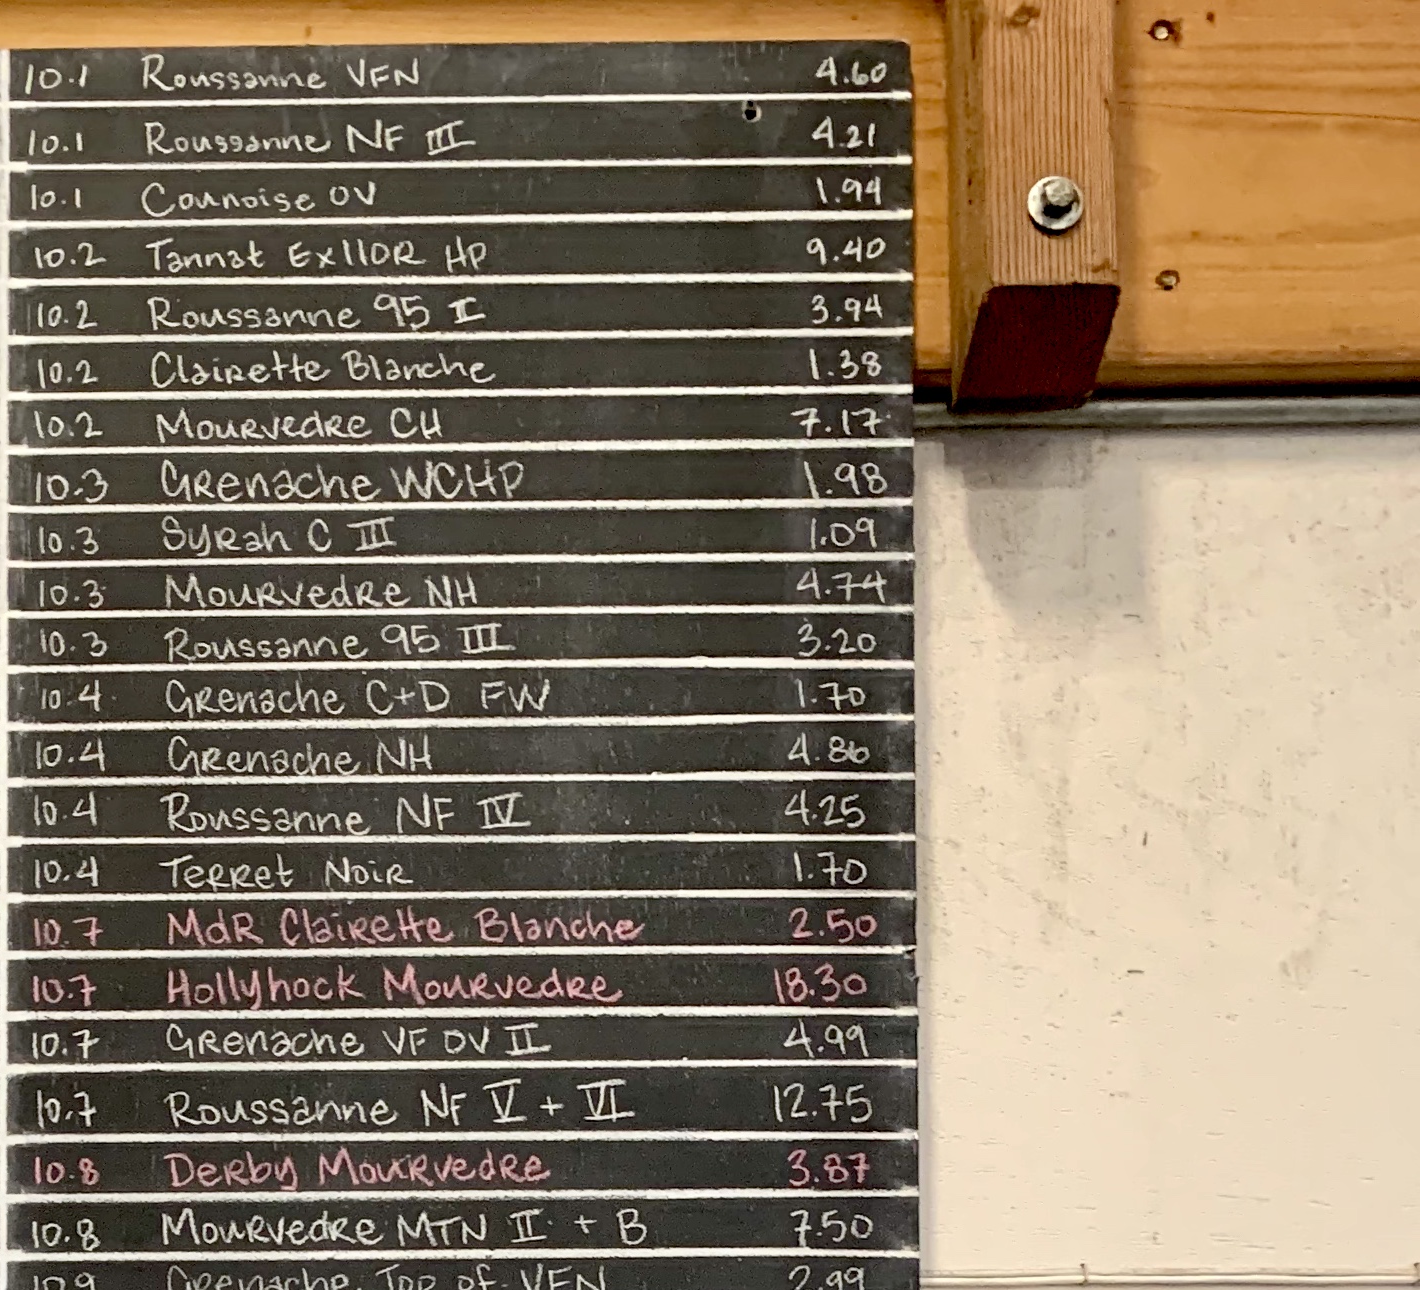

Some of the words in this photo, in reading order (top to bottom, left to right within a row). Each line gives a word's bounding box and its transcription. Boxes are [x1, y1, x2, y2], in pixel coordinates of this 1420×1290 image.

[25, 65, 87, 94] 10.1
[142, 54, 326, 91] Roussanne
[347, 59, 419, 87] VFN
[816, 57, 886, 85] 4.60
[29, 130, 83, 155] 10.1
[145, 122, 331, 154] Roussanne
[347, 120, 403, 152] NF
[426, 120, 475, 155] III
[812, 117, 875, 148] 4.21
[32, 185, 81, 210] 10.1
[142, 183, 315, 217] Counoise
[330, 182, 375, 205] OV
[817, 177, 880, 204] 1.94
[38, 300, 97, 329] 10.2
[148, 297, 360, 330] Roussanne
[374, 294, 429, 330] 95
[812, 294, 882, 324] 3.94
[42, 632, 107, 656] 10.3
[164, 628, 367, 661] Roussanne
[382, 625, 440, 654] 95
[458, 623, 514, 653] III
[799, 624, 876, 656] 3.20
[35, 792, 96, 825] 10.4
[164, 793, 371, 834] Roussanne
[397, 793, 454, 833] NF
[477, 793, 530, 829] IV
[785, 790, 865, 828] 4.25
[34, 917, 102, 946] 10.7
[168, 909, 262, 946] MdR
[475, 908, 644, 942] Blanche
[791, 908, 876, 942] 2.50
[37, 1090, 96, 1128] 10.7
[164, 1092, 398, 1127] Roussanne
[421, 1083, 466, 1126] NF
[483, 1079, 526, 1123] V
[577, 1079, 635, 1121] VI
[774, 1083, 872, 1123] 12.75
[35, 1157, 99, 1185] 10.8
[788, 1150, 868, 1186] 3.87
